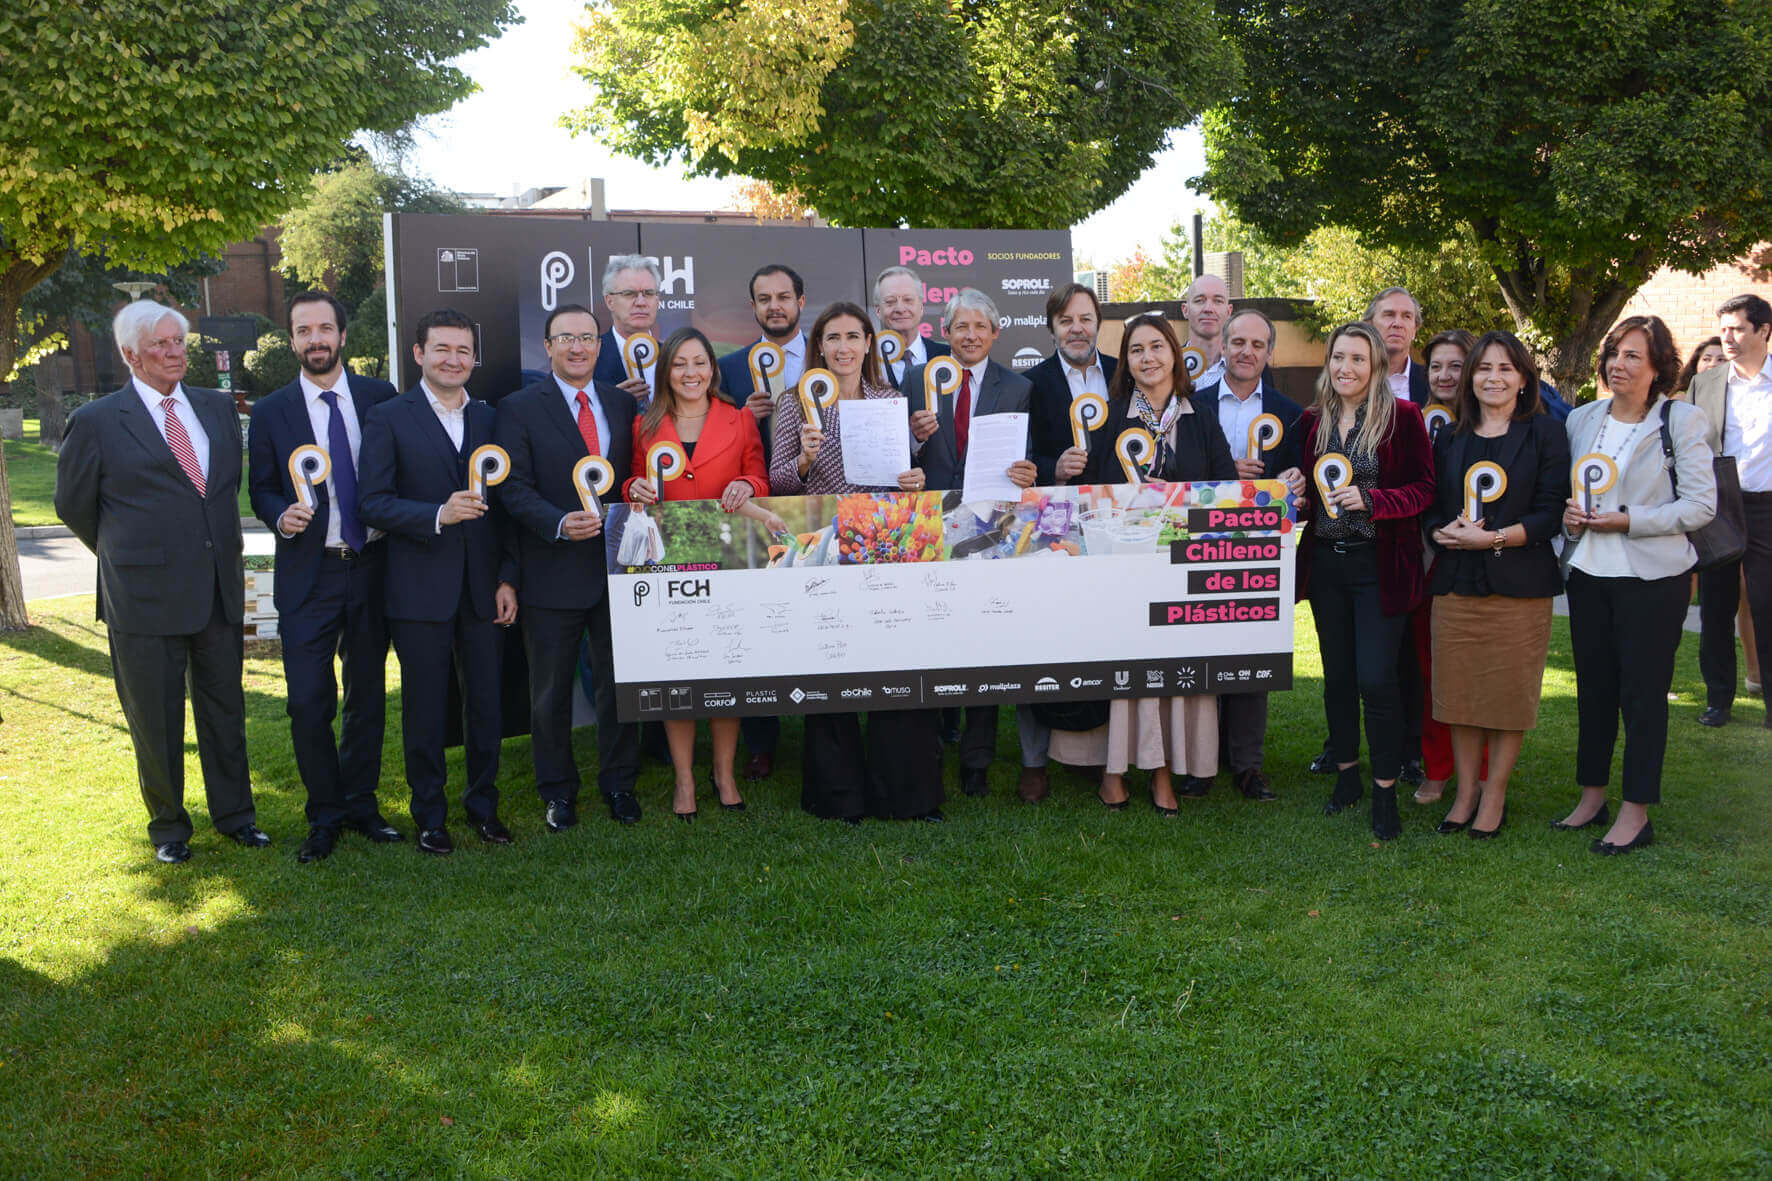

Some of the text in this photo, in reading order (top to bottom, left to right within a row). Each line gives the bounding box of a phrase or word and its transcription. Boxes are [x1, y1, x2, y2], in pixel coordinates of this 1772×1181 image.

[899, 245, 974, 266] Pacto
[987, 252, 1062, 260] SOCIOS FUNDADORES
[1002, 278, 1050, 290] SOPROLE
[667, 300, 695, 309] CHILE
[1208, 509, 1279, 528] Pacto
[1186, 540, 1278, 561] Chileno
[667, 579, 711, 598] FCH
[1205, 571, 1277, 590] de los
[1167, 601, 1277, 624] Plásticos
[704, 699, 733, 708] CORFO
[746, 696, 778, 704] OCEANS
